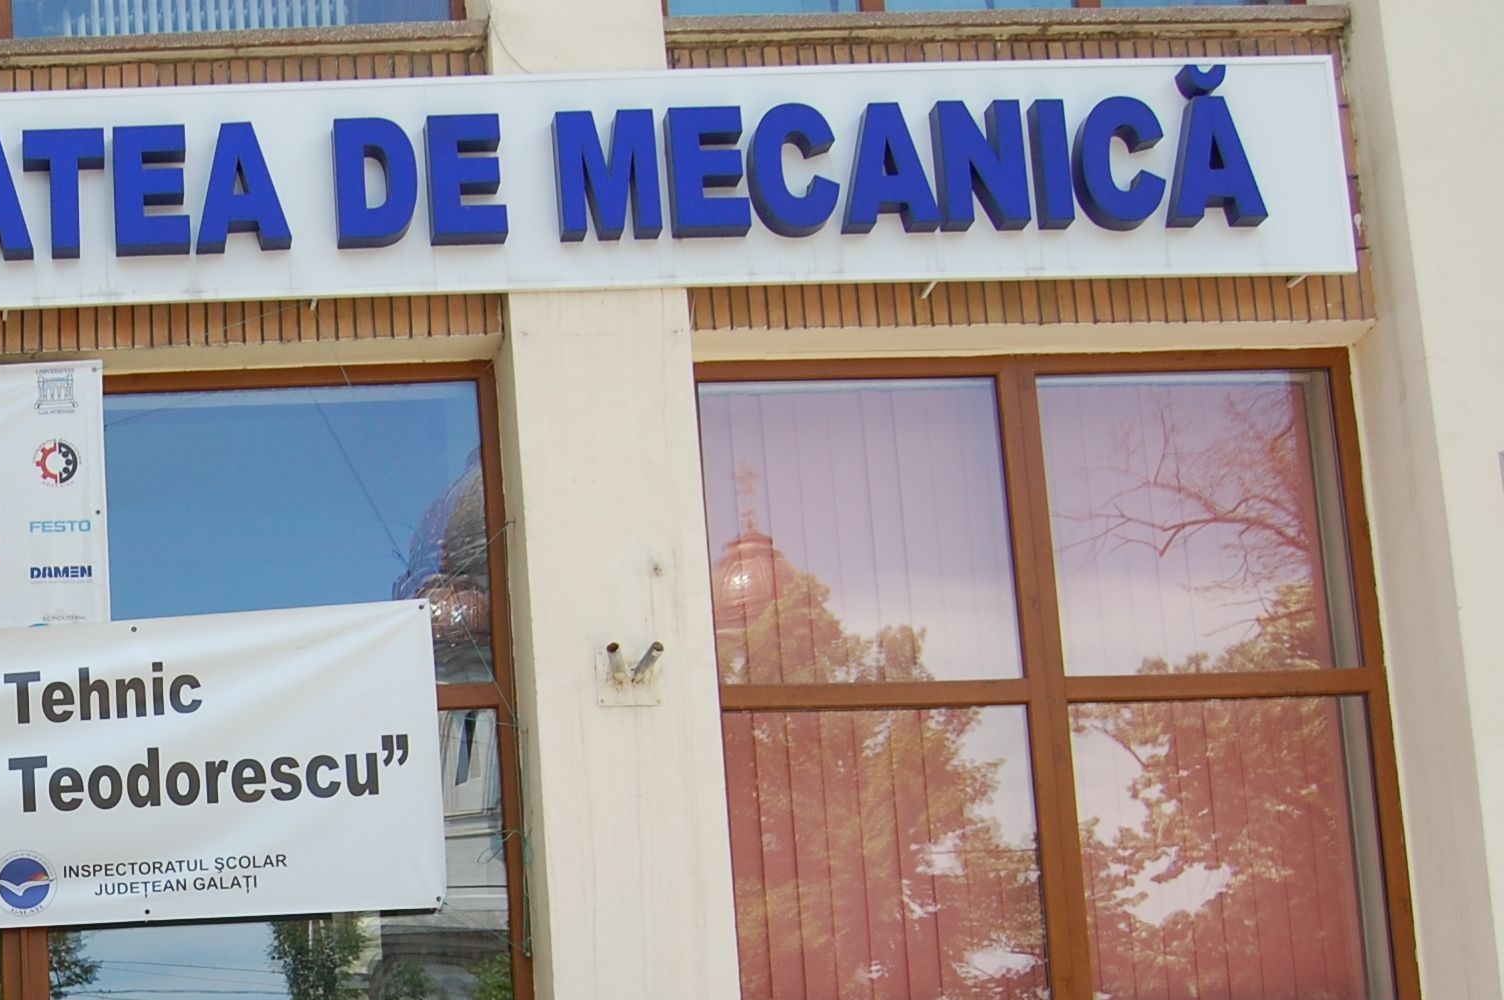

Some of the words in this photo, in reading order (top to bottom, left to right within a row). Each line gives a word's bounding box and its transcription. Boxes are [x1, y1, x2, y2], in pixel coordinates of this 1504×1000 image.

[330, 113, 509, 250] DE
[551, 64, 1269, 243] MECANICĂ
[29, 519, 91, 534] FESTO
[30, 565, 92, 579] DAMEN
[3, 661, 203, 724] Tehnic
[63, 859, 209, 878] INSPECTORATUL
